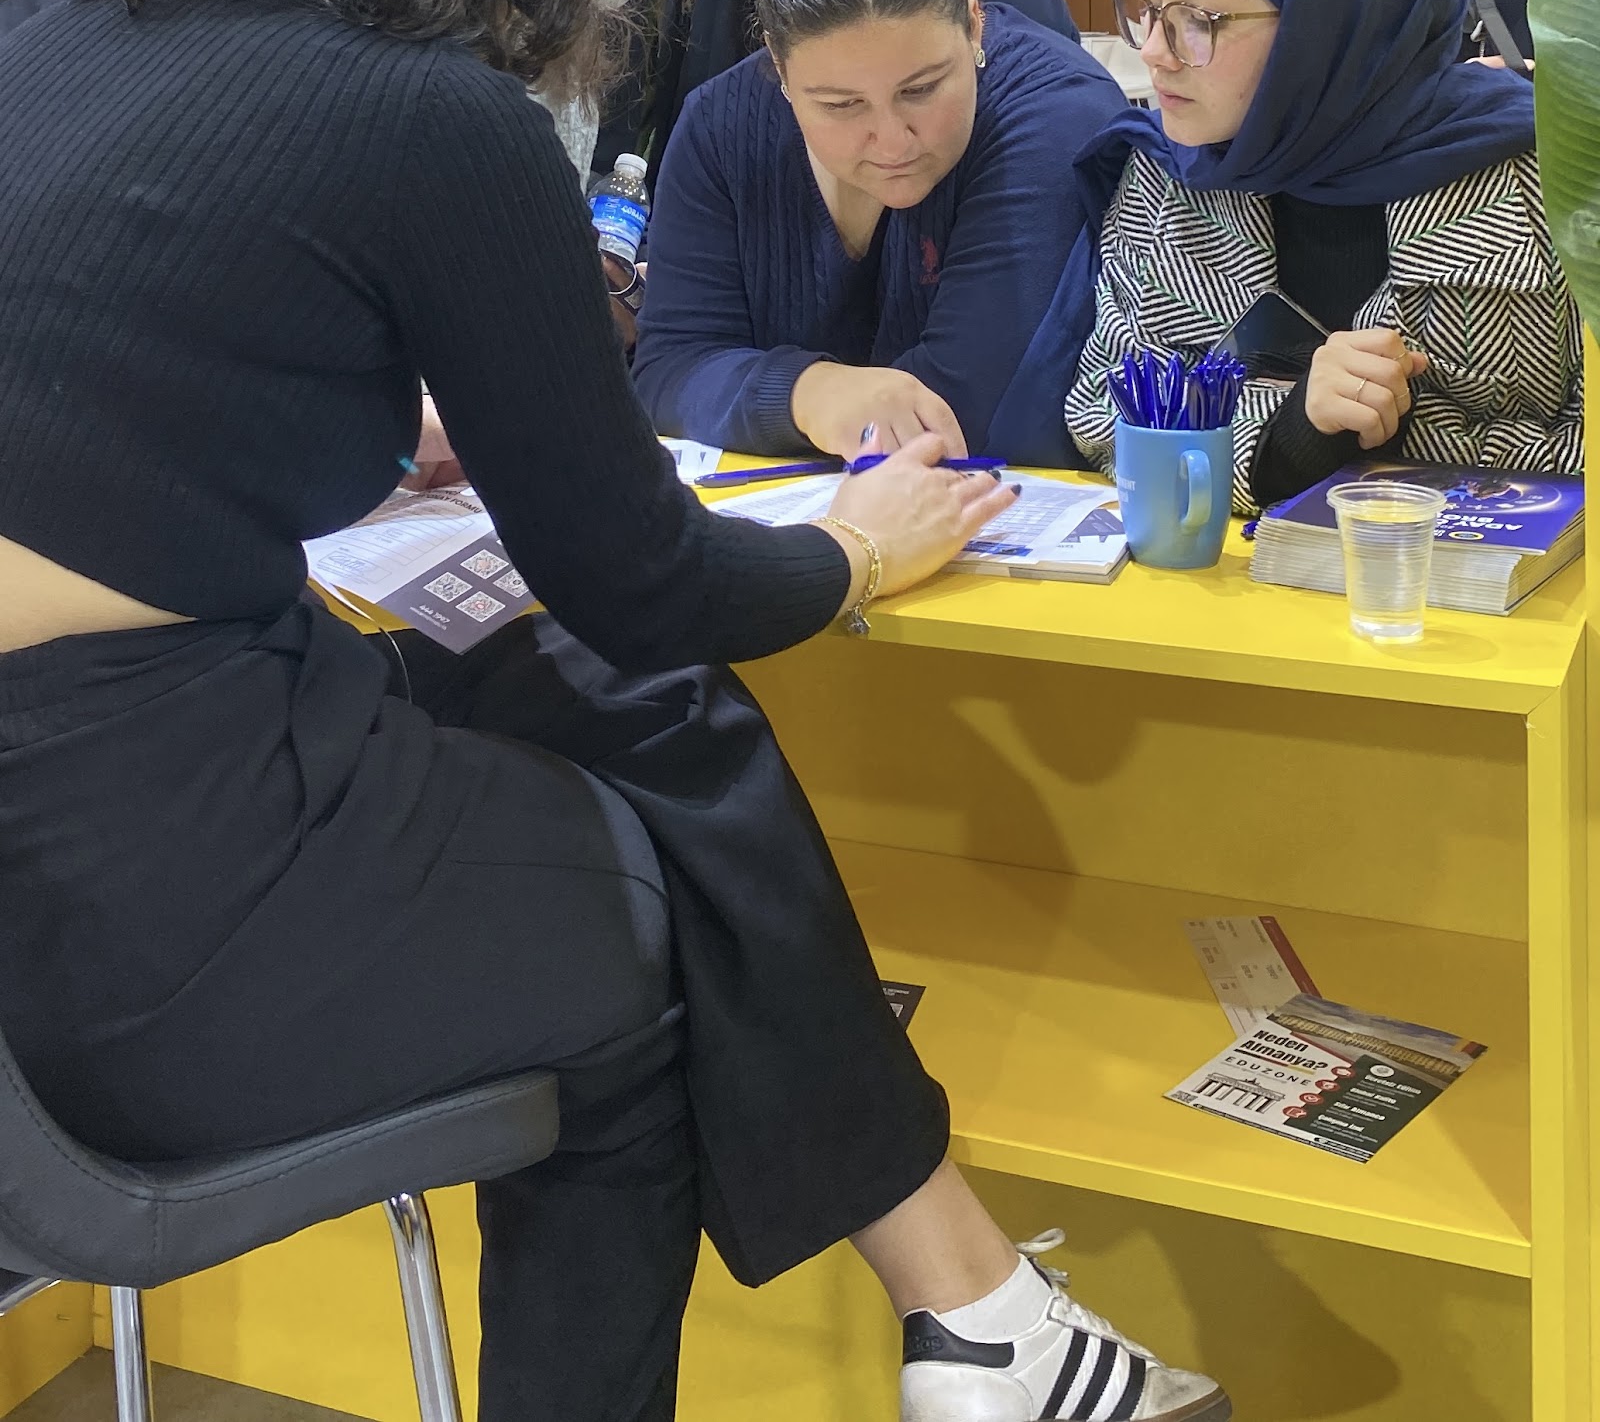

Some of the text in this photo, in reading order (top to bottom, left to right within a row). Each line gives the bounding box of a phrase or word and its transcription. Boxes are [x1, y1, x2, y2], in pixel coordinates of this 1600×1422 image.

[450, 498, 482, 513] FORMU
[1453, 521, 1523, 531] ADAY
[1253, 1030, 1309, 1052] Neden
[1240, 1040, 1328, 1070] Almanya?
[1225, 1056, 1311, 1086] EDUZONE
